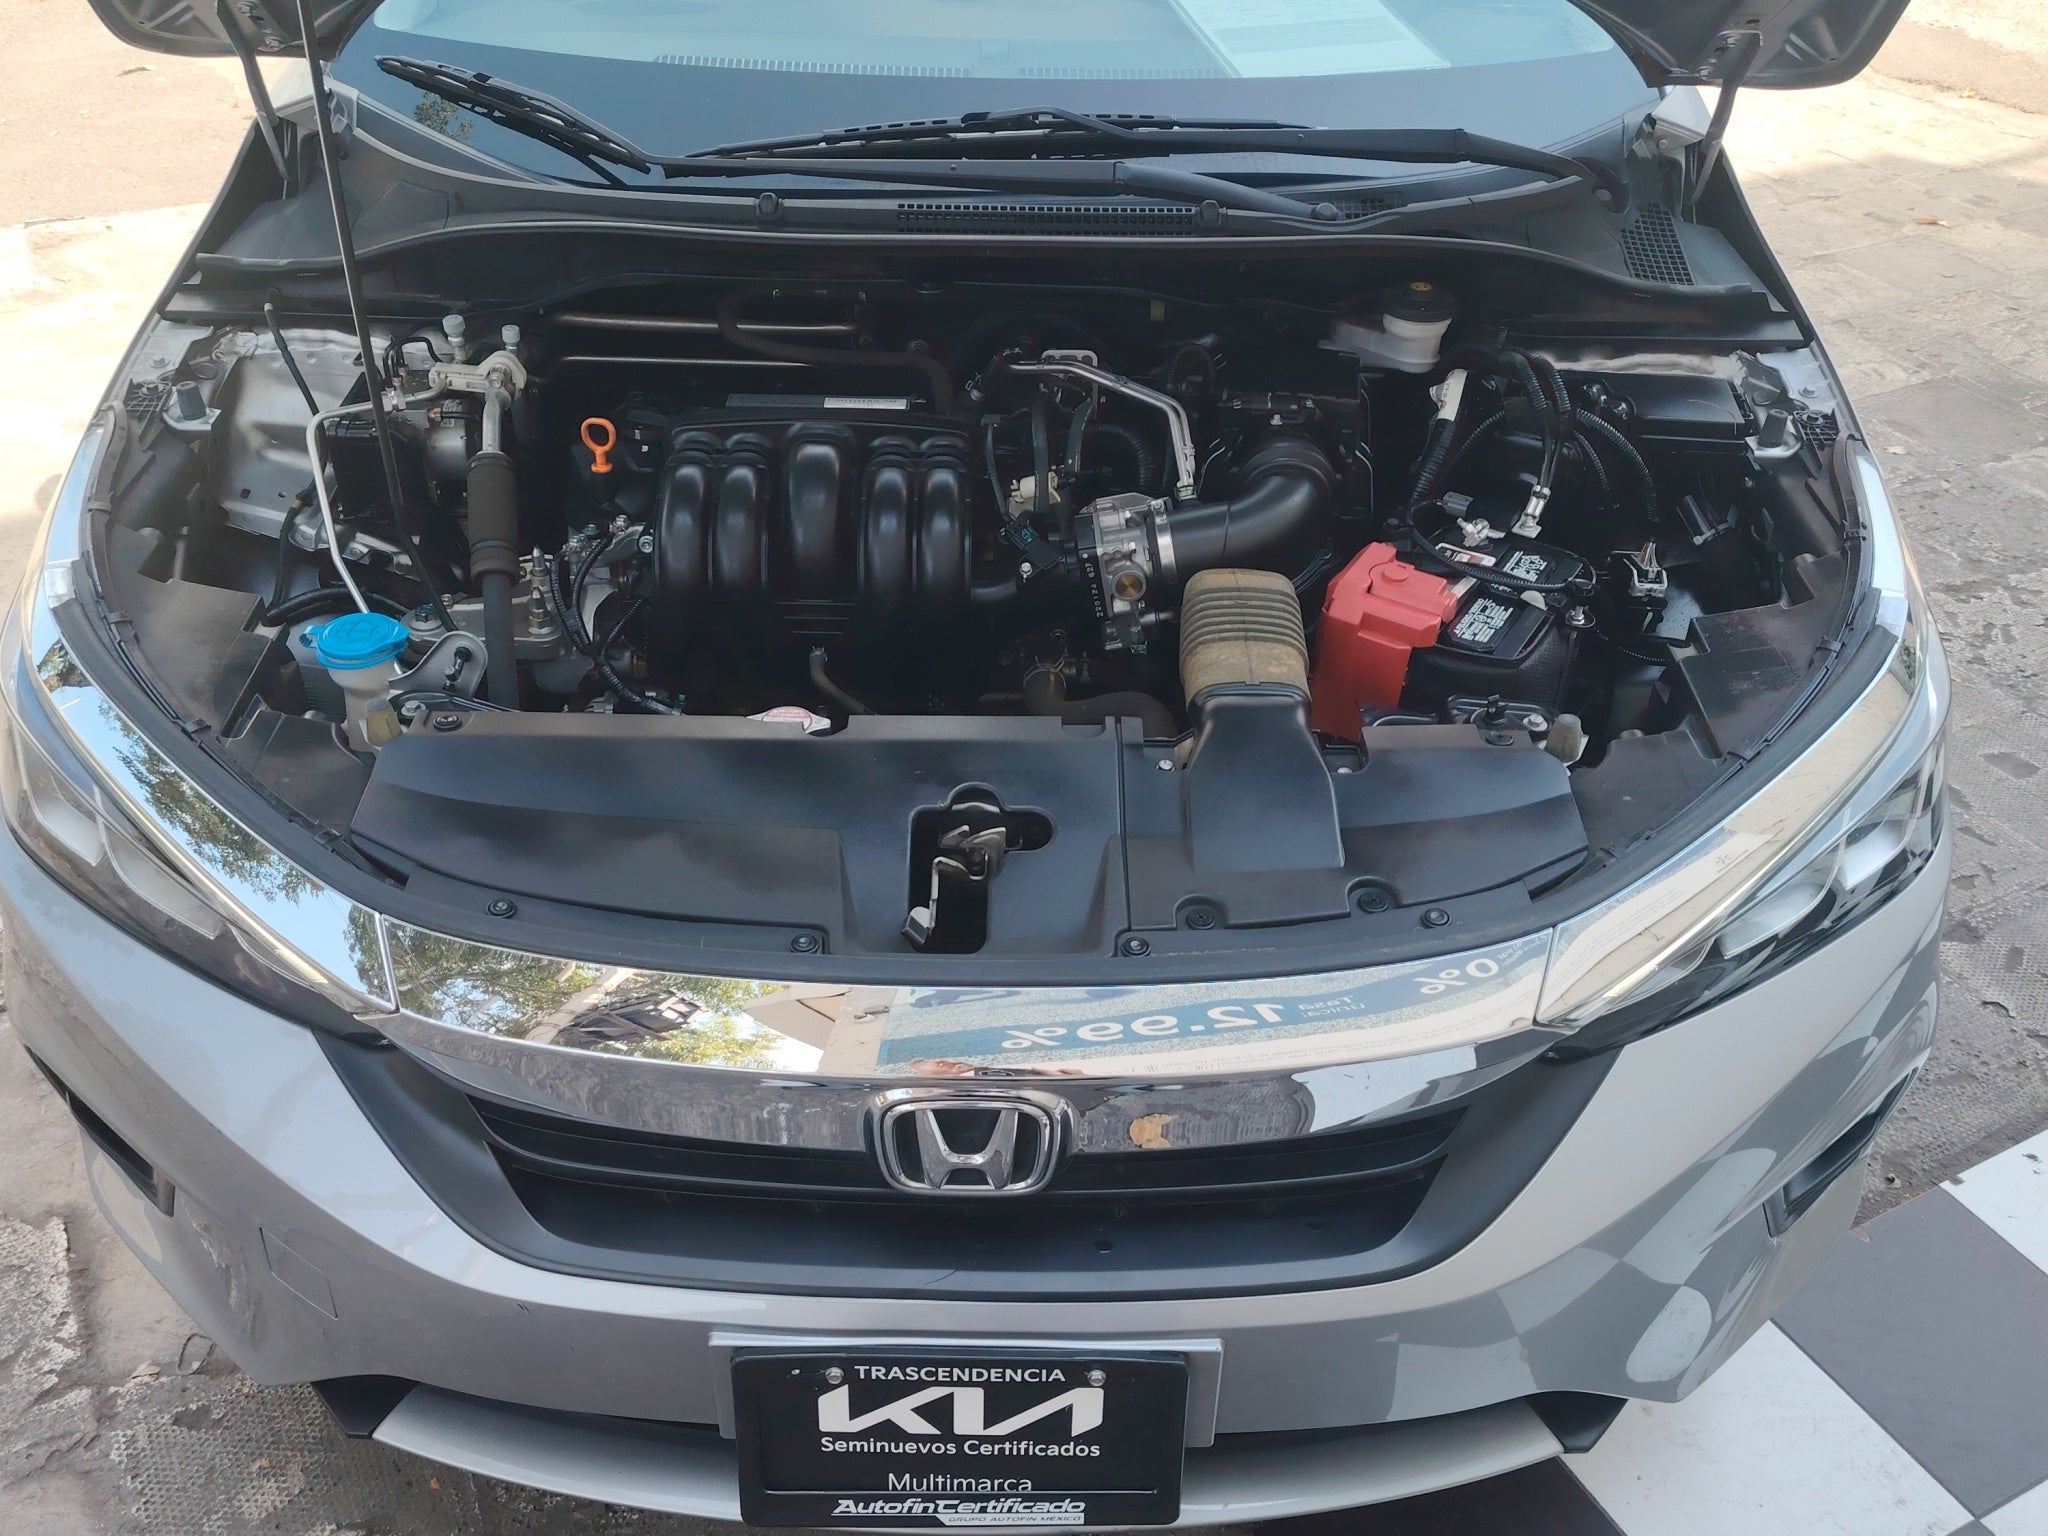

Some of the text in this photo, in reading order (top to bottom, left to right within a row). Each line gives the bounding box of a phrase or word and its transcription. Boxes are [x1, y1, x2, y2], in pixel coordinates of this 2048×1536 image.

[854, 1365, 1066, 1382] TRASCENDENCIA
[820, 1436, 1101, 1457] Seminuevos Certificados
[888, 1472, 1032, 1492] Multimarca
